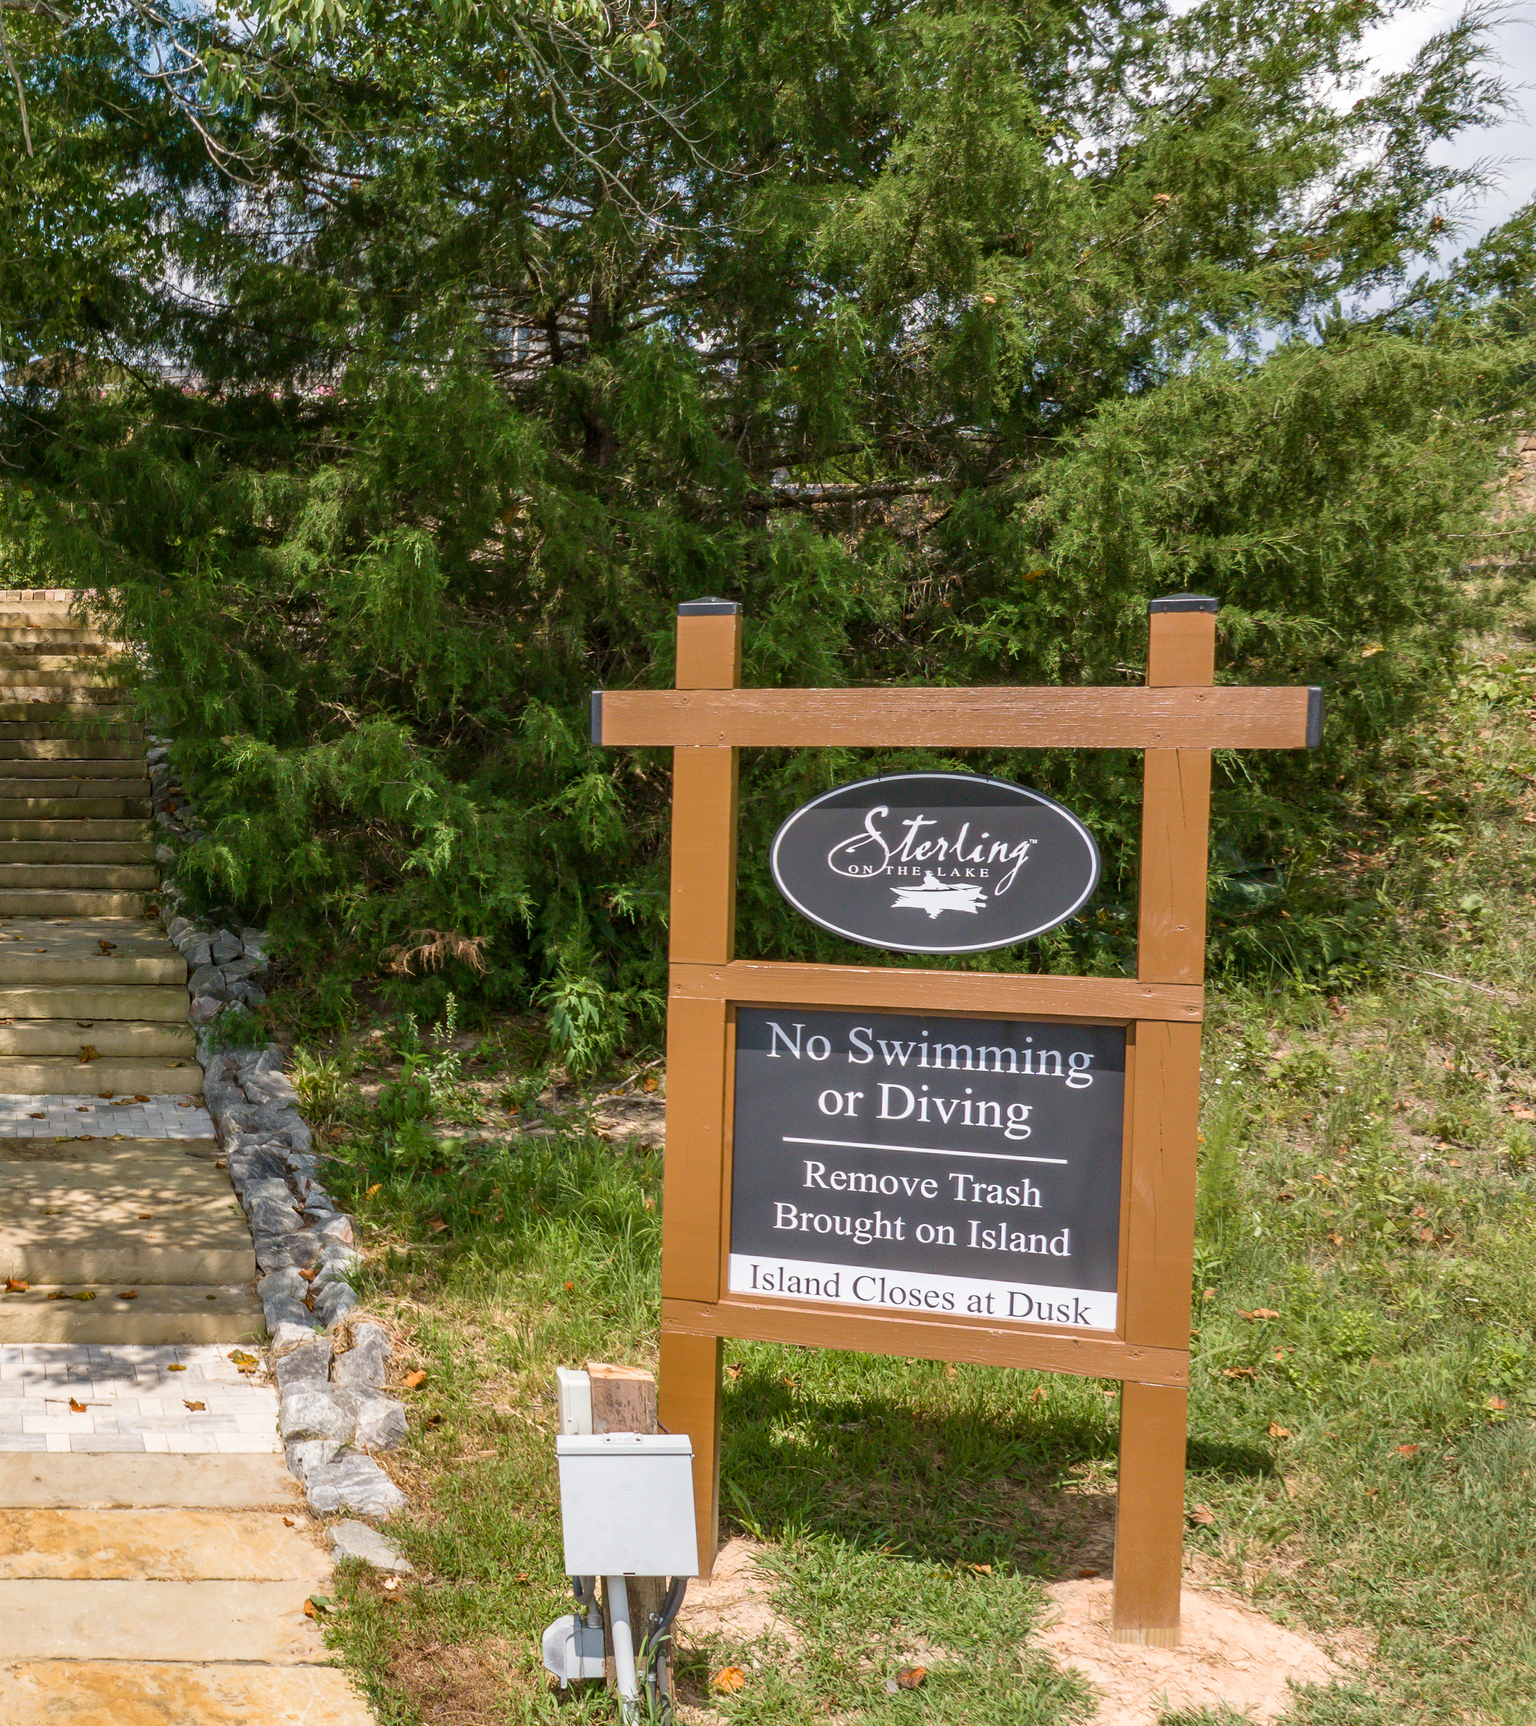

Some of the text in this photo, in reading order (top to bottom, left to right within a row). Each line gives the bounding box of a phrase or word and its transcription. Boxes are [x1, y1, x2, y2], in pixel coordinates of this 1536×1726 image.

[828, 805, 1030, 896] Sterling
[848, 864, 990, 878] ON THE LAKE
[765, 1021, 1095, 1089] No Swimming
[818, 1083, 1033, 1140] or Diving
[802, 1160, 1043, 1208] Remove Trash
[773, 1201, 1071, 1257] Brought on Island
[749, 1264, 1093, 1326] Island Closes at Dusk
